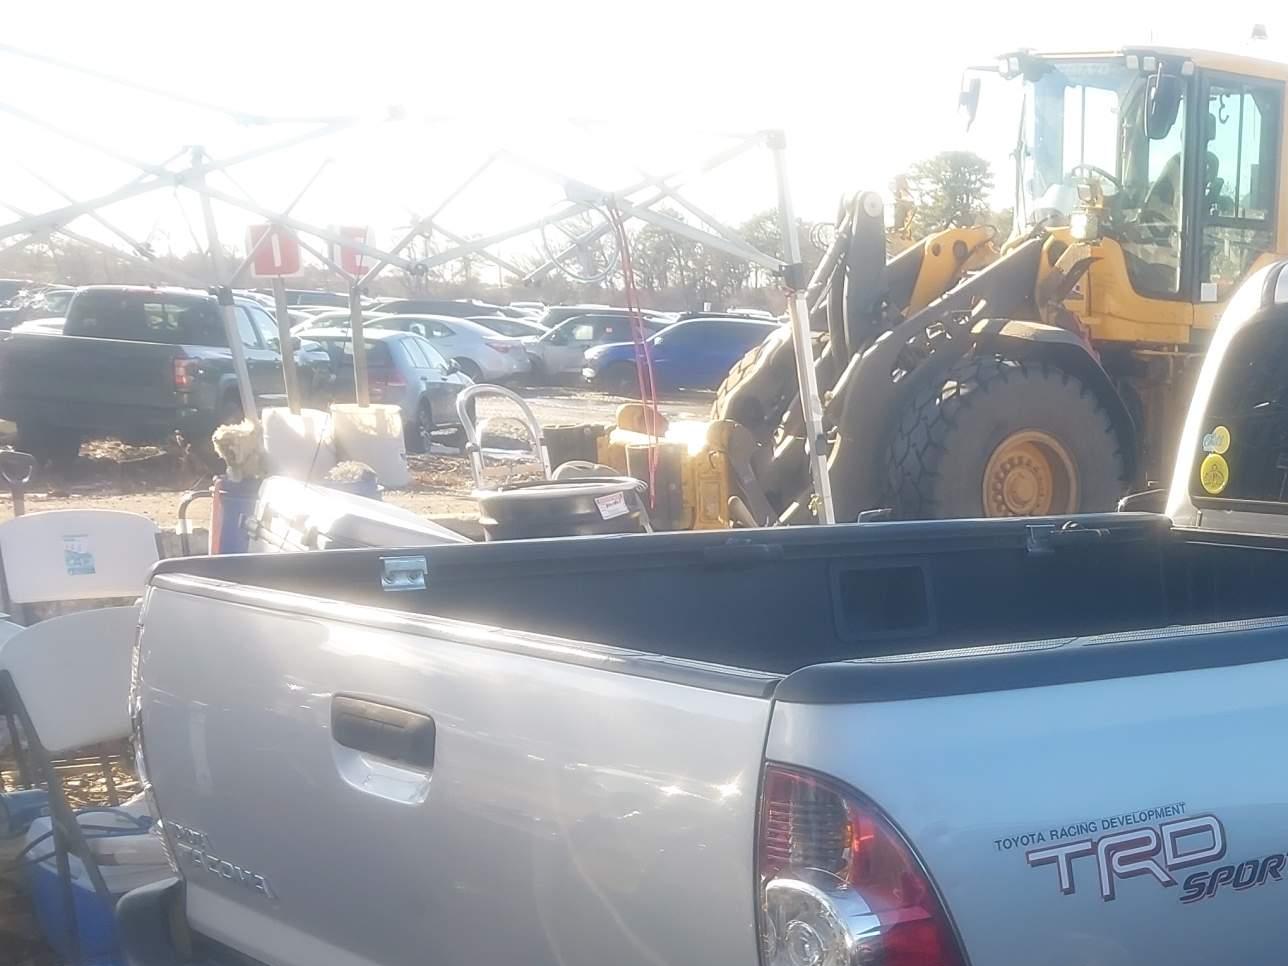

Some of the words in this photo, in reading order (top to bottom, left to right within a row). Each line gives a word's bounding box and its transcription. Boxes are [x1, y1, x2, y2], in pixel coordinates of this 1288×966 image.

[994, 831, 1046, 852] TOYOTA
[1050, 821, 1098, 841] RACING
[1102, 802, 1187, 832] DEVELOPMENT
[1025, 814, 1228, 902] TRD
